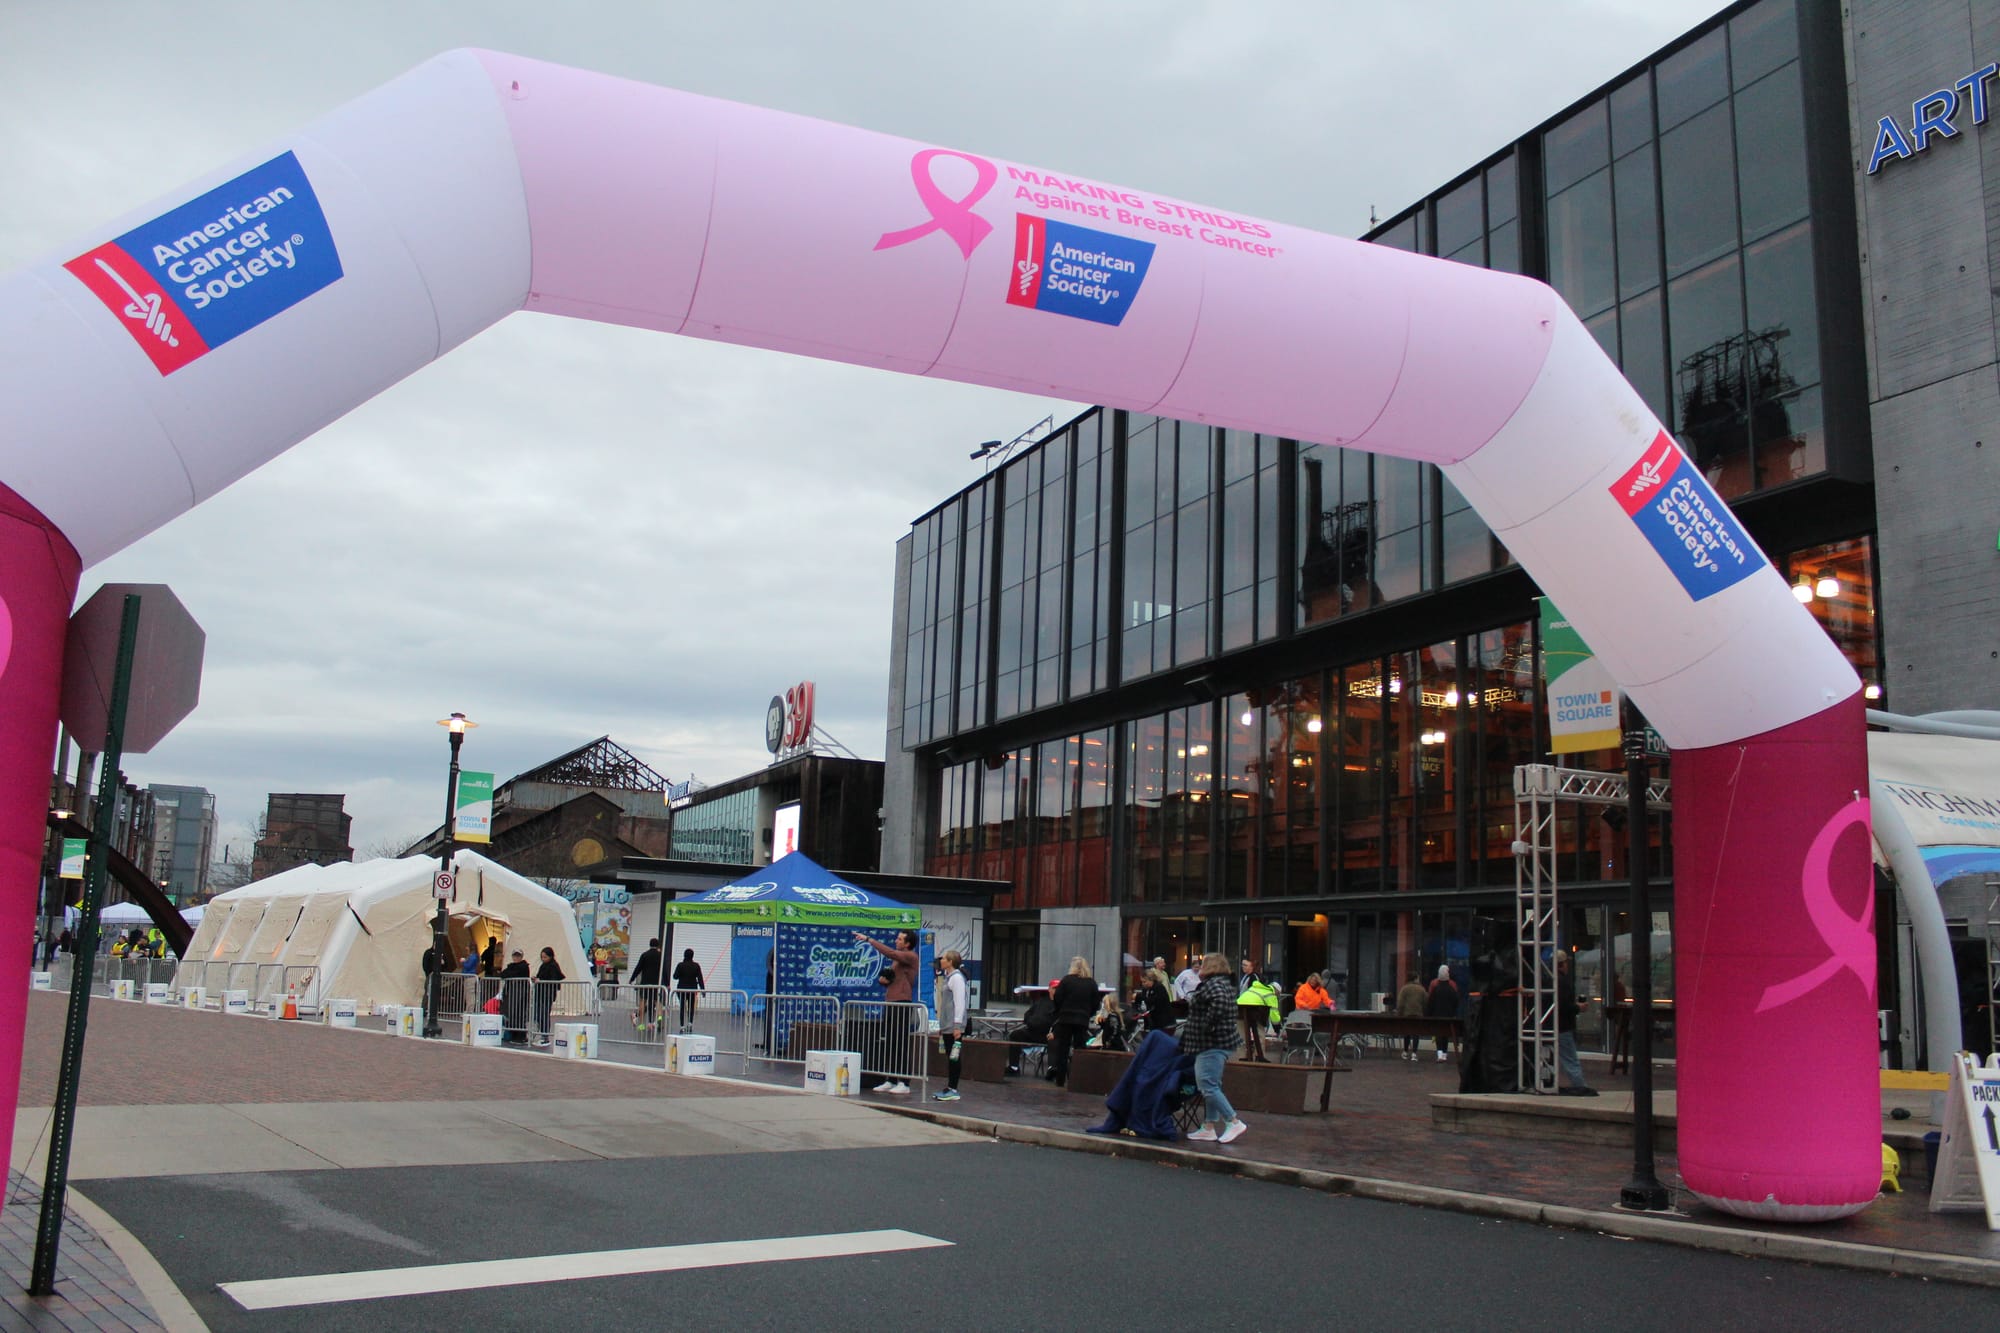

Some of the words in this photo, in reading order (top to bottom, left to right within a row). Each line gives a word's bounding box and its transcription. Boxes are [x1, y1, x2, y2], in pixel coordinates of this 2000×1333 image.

[1006, 166, 1145, 209] MAKING
[1152, 200, 1272, 239] STRIDES
[1015, 185, 1110, 220] Against
[1117, 208, 1194, 240] Breast
[152, 186, 295, 267] American
[167, 222, 271, 284] Cancer
[1051, 241, 1135, 274] American
[1050, 257, 1111, 284] Cancer
[1669, 486, 1721, 550] Cancer
[1677, 477, 1745, 565] American
[784, 680, 813, 749] 39
[1556, 693, 1597, 708] TOWN
[1557, 705, 1613, 722] SQUARE
[1885, 785, 2000, 817] HIGHM
[811, 946, 863, 963] Second
[833, 962, 869, 978] Wind
[809, 1072, 825, 1080] FLIGHT
